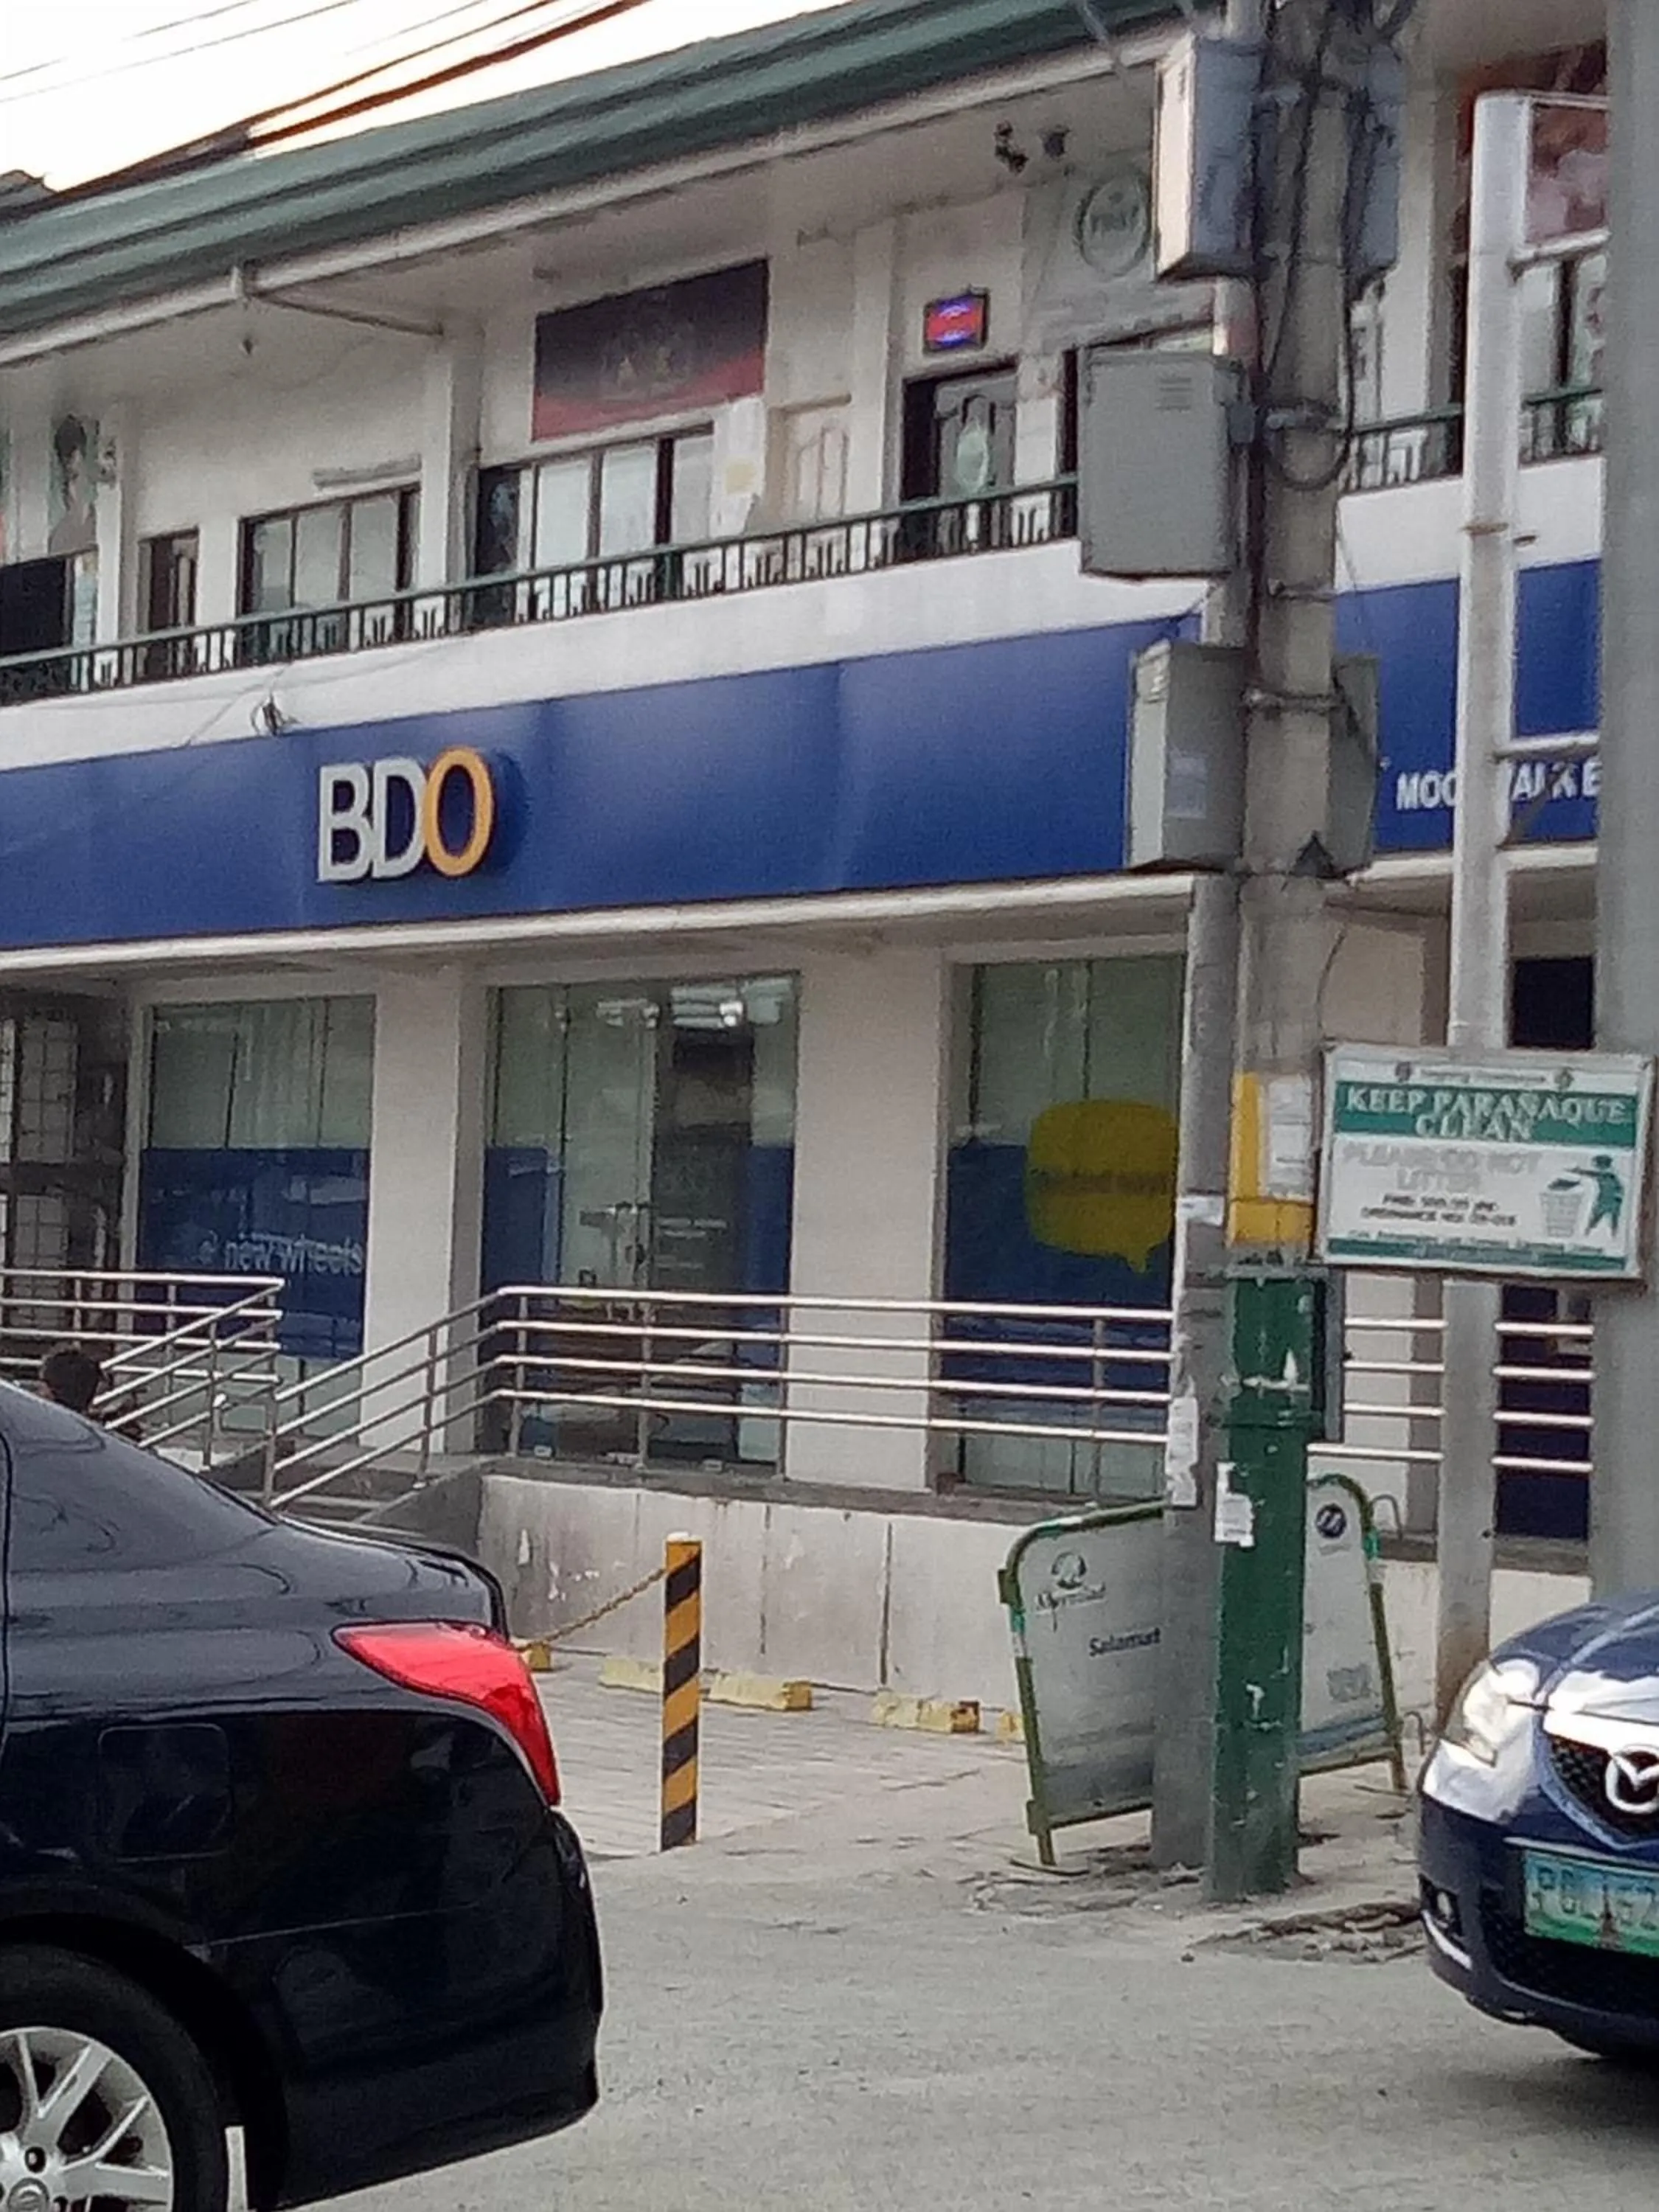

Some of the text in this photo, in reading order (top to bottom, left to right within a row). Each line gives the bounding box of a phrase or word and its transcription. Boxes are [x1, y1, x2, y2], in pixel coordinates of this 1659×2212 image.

[319, 748, 493, 882] BDO
[1347, 1085, 1427, 1114] KEEP
[1416, 1114, 1536, 1142] CLEAN
